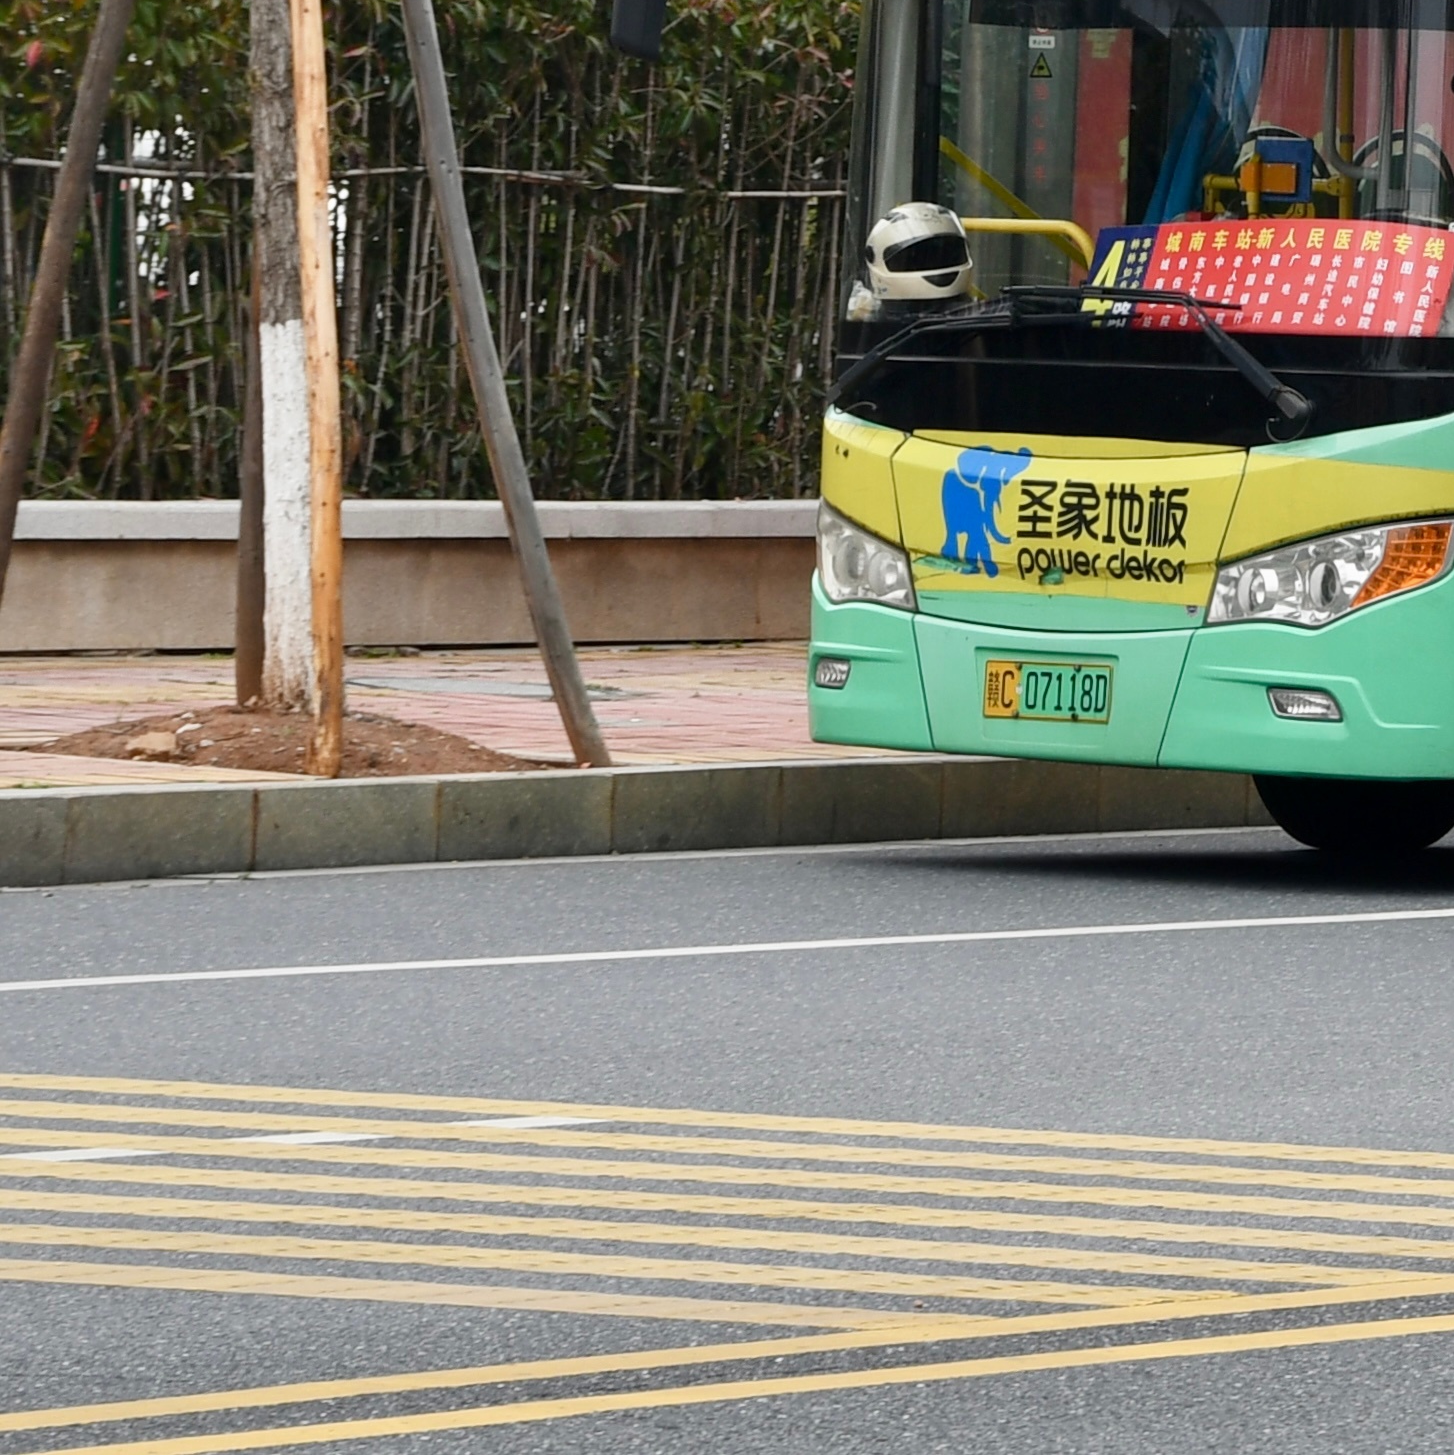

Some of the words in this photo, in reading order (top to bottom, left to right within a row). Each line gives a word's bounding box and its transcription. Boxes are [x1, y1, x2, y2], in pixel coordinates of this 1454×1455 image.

[1165, 227, 1446, 261] 城南车站-新人民医院专线
[1252, 253, 1281, 324] 建设银行
[1270, 253, 1301, 324] 广电局
[1312, 254, 1342, 325] 长途汽车站
[1334, 255, 1366, 327] 市民中心
[1357, 257, 1389, 329] 妇幼保健院
[1383, 260, 1414, 333] 图书馆
[1408, 264, 1439, 337] 新人民医院
[1016, 478, 1190, 548] 圣象地板
